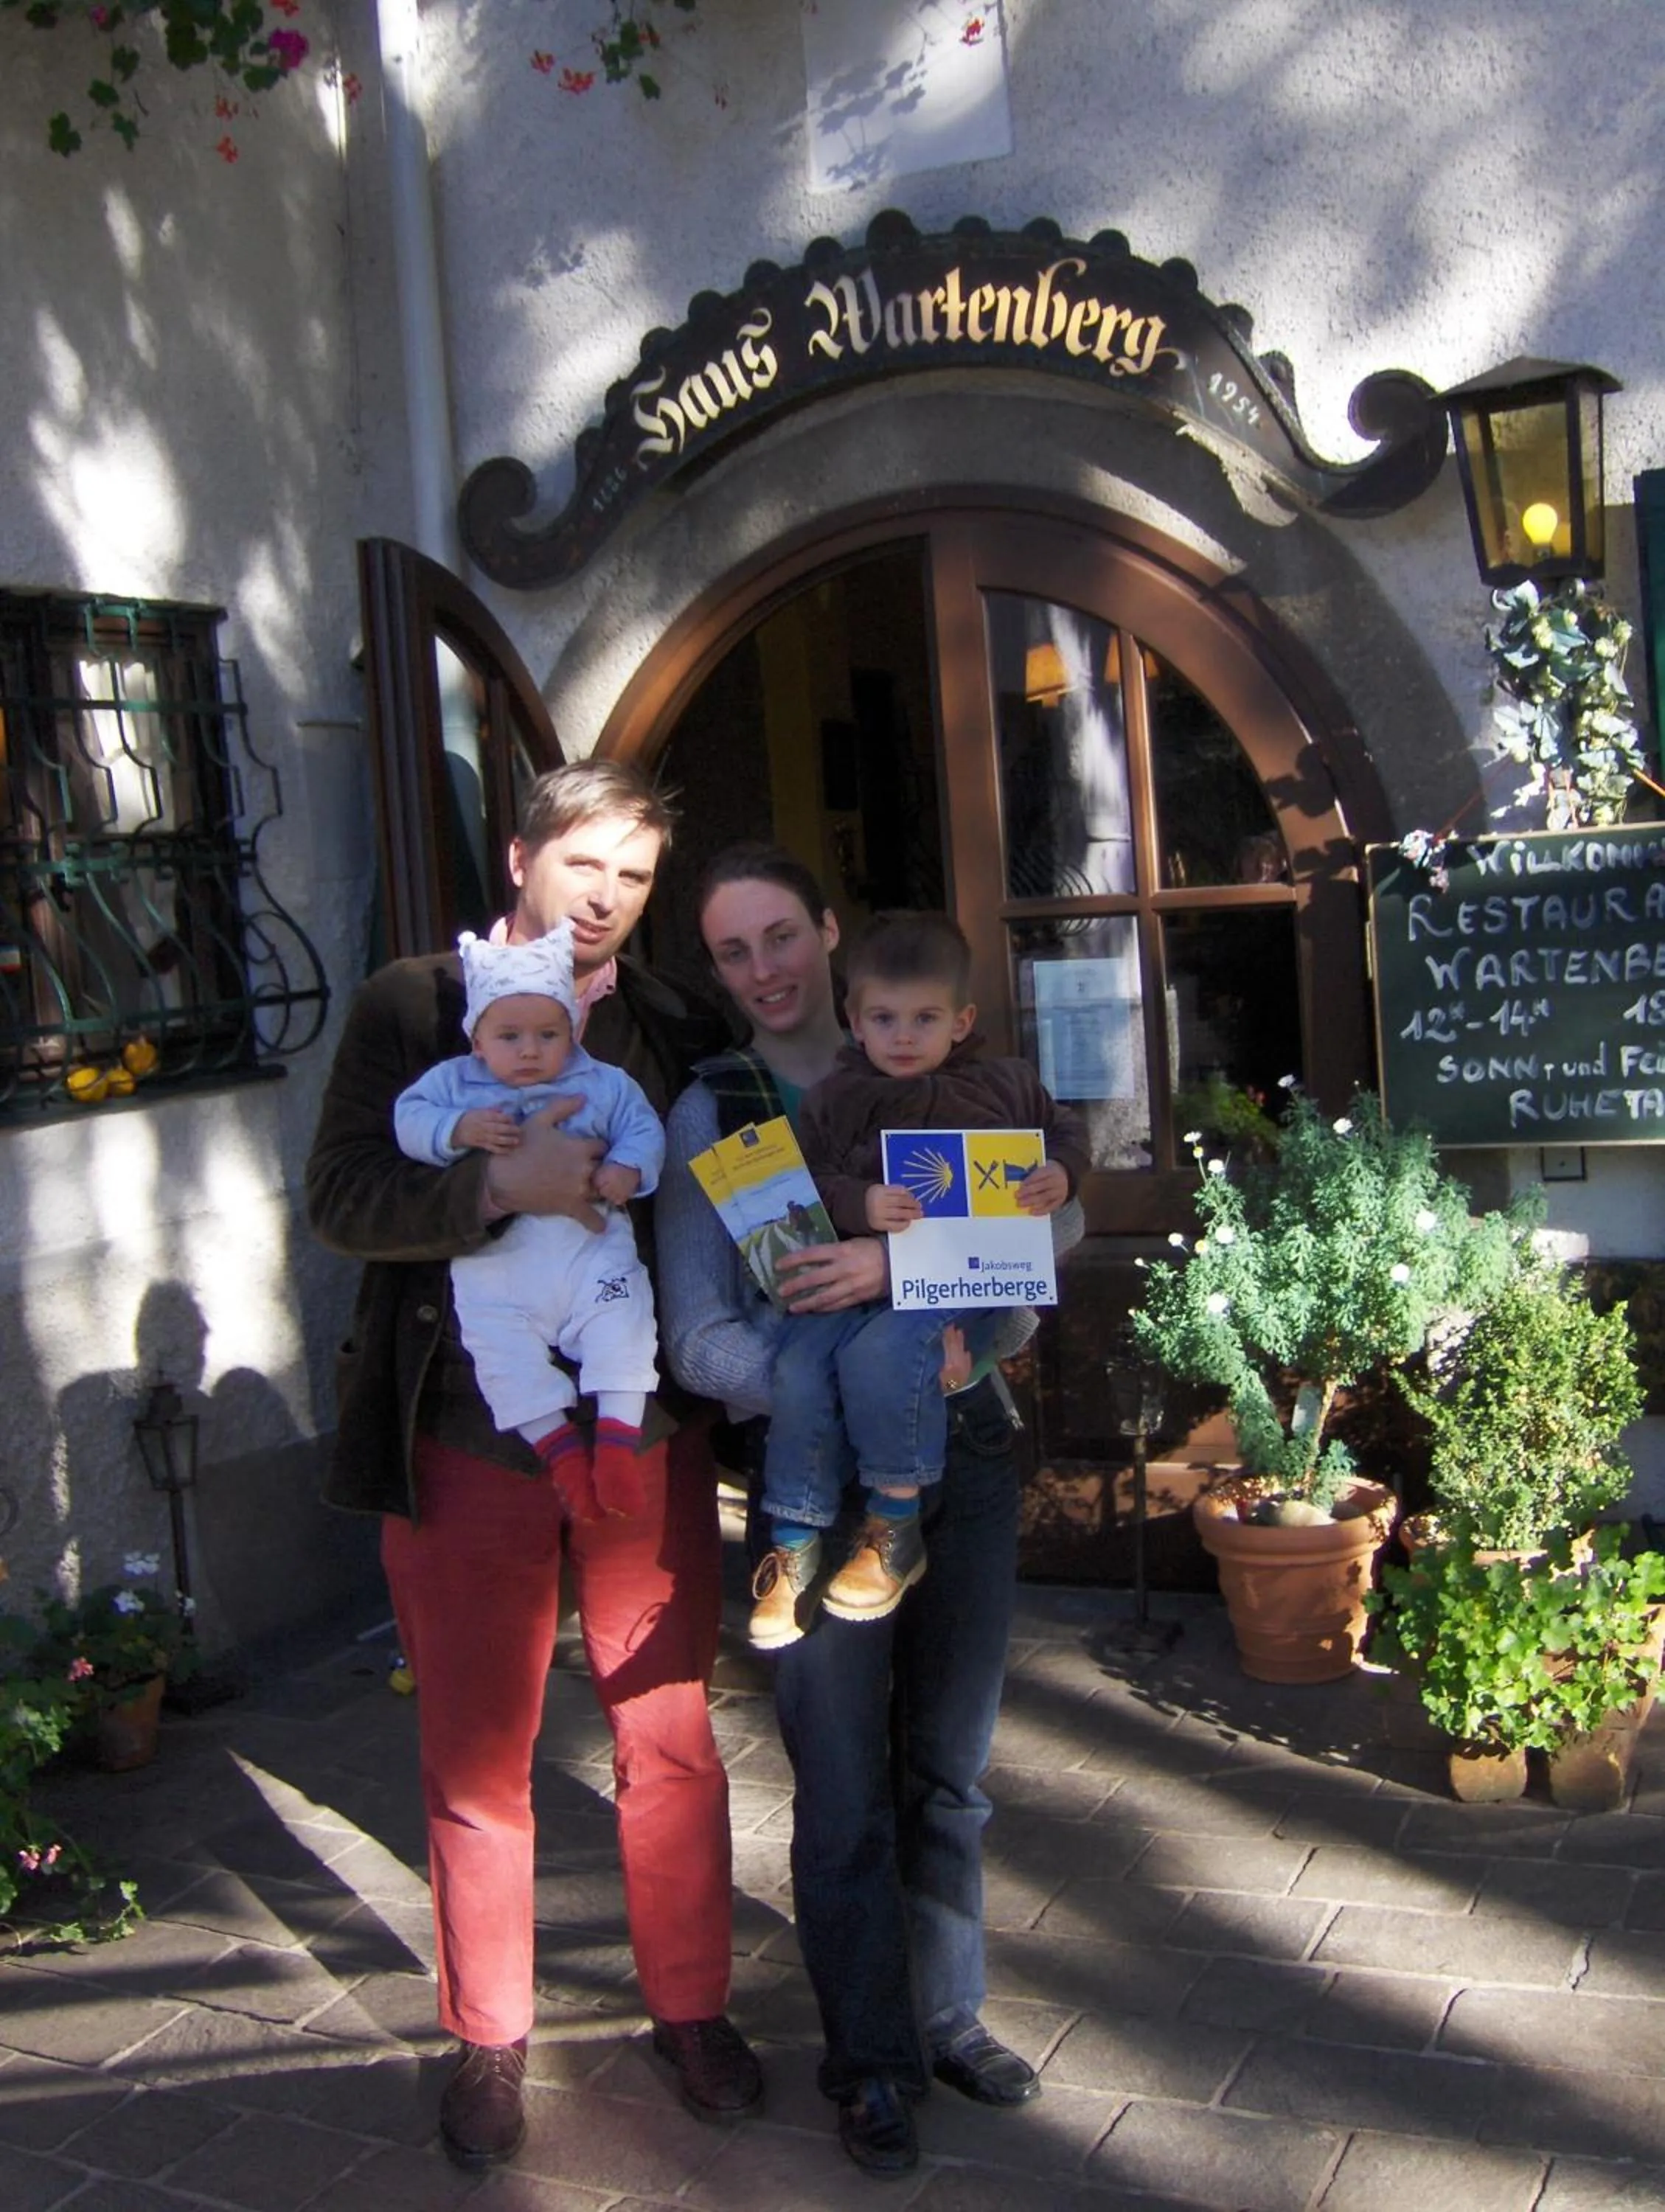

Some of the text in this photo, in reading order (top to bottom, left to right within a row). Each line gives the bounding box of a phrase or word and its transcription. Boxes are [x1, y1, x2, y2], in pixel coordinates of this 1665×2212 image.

[630, 257, 1185, 470] Haus Wartenberg
[1209, 371, 1259, 425] 1954
[981, 1260, 1032, 1273] Jakobsweg
[902, 1277, 1047, 1304] Pilgerherberge
